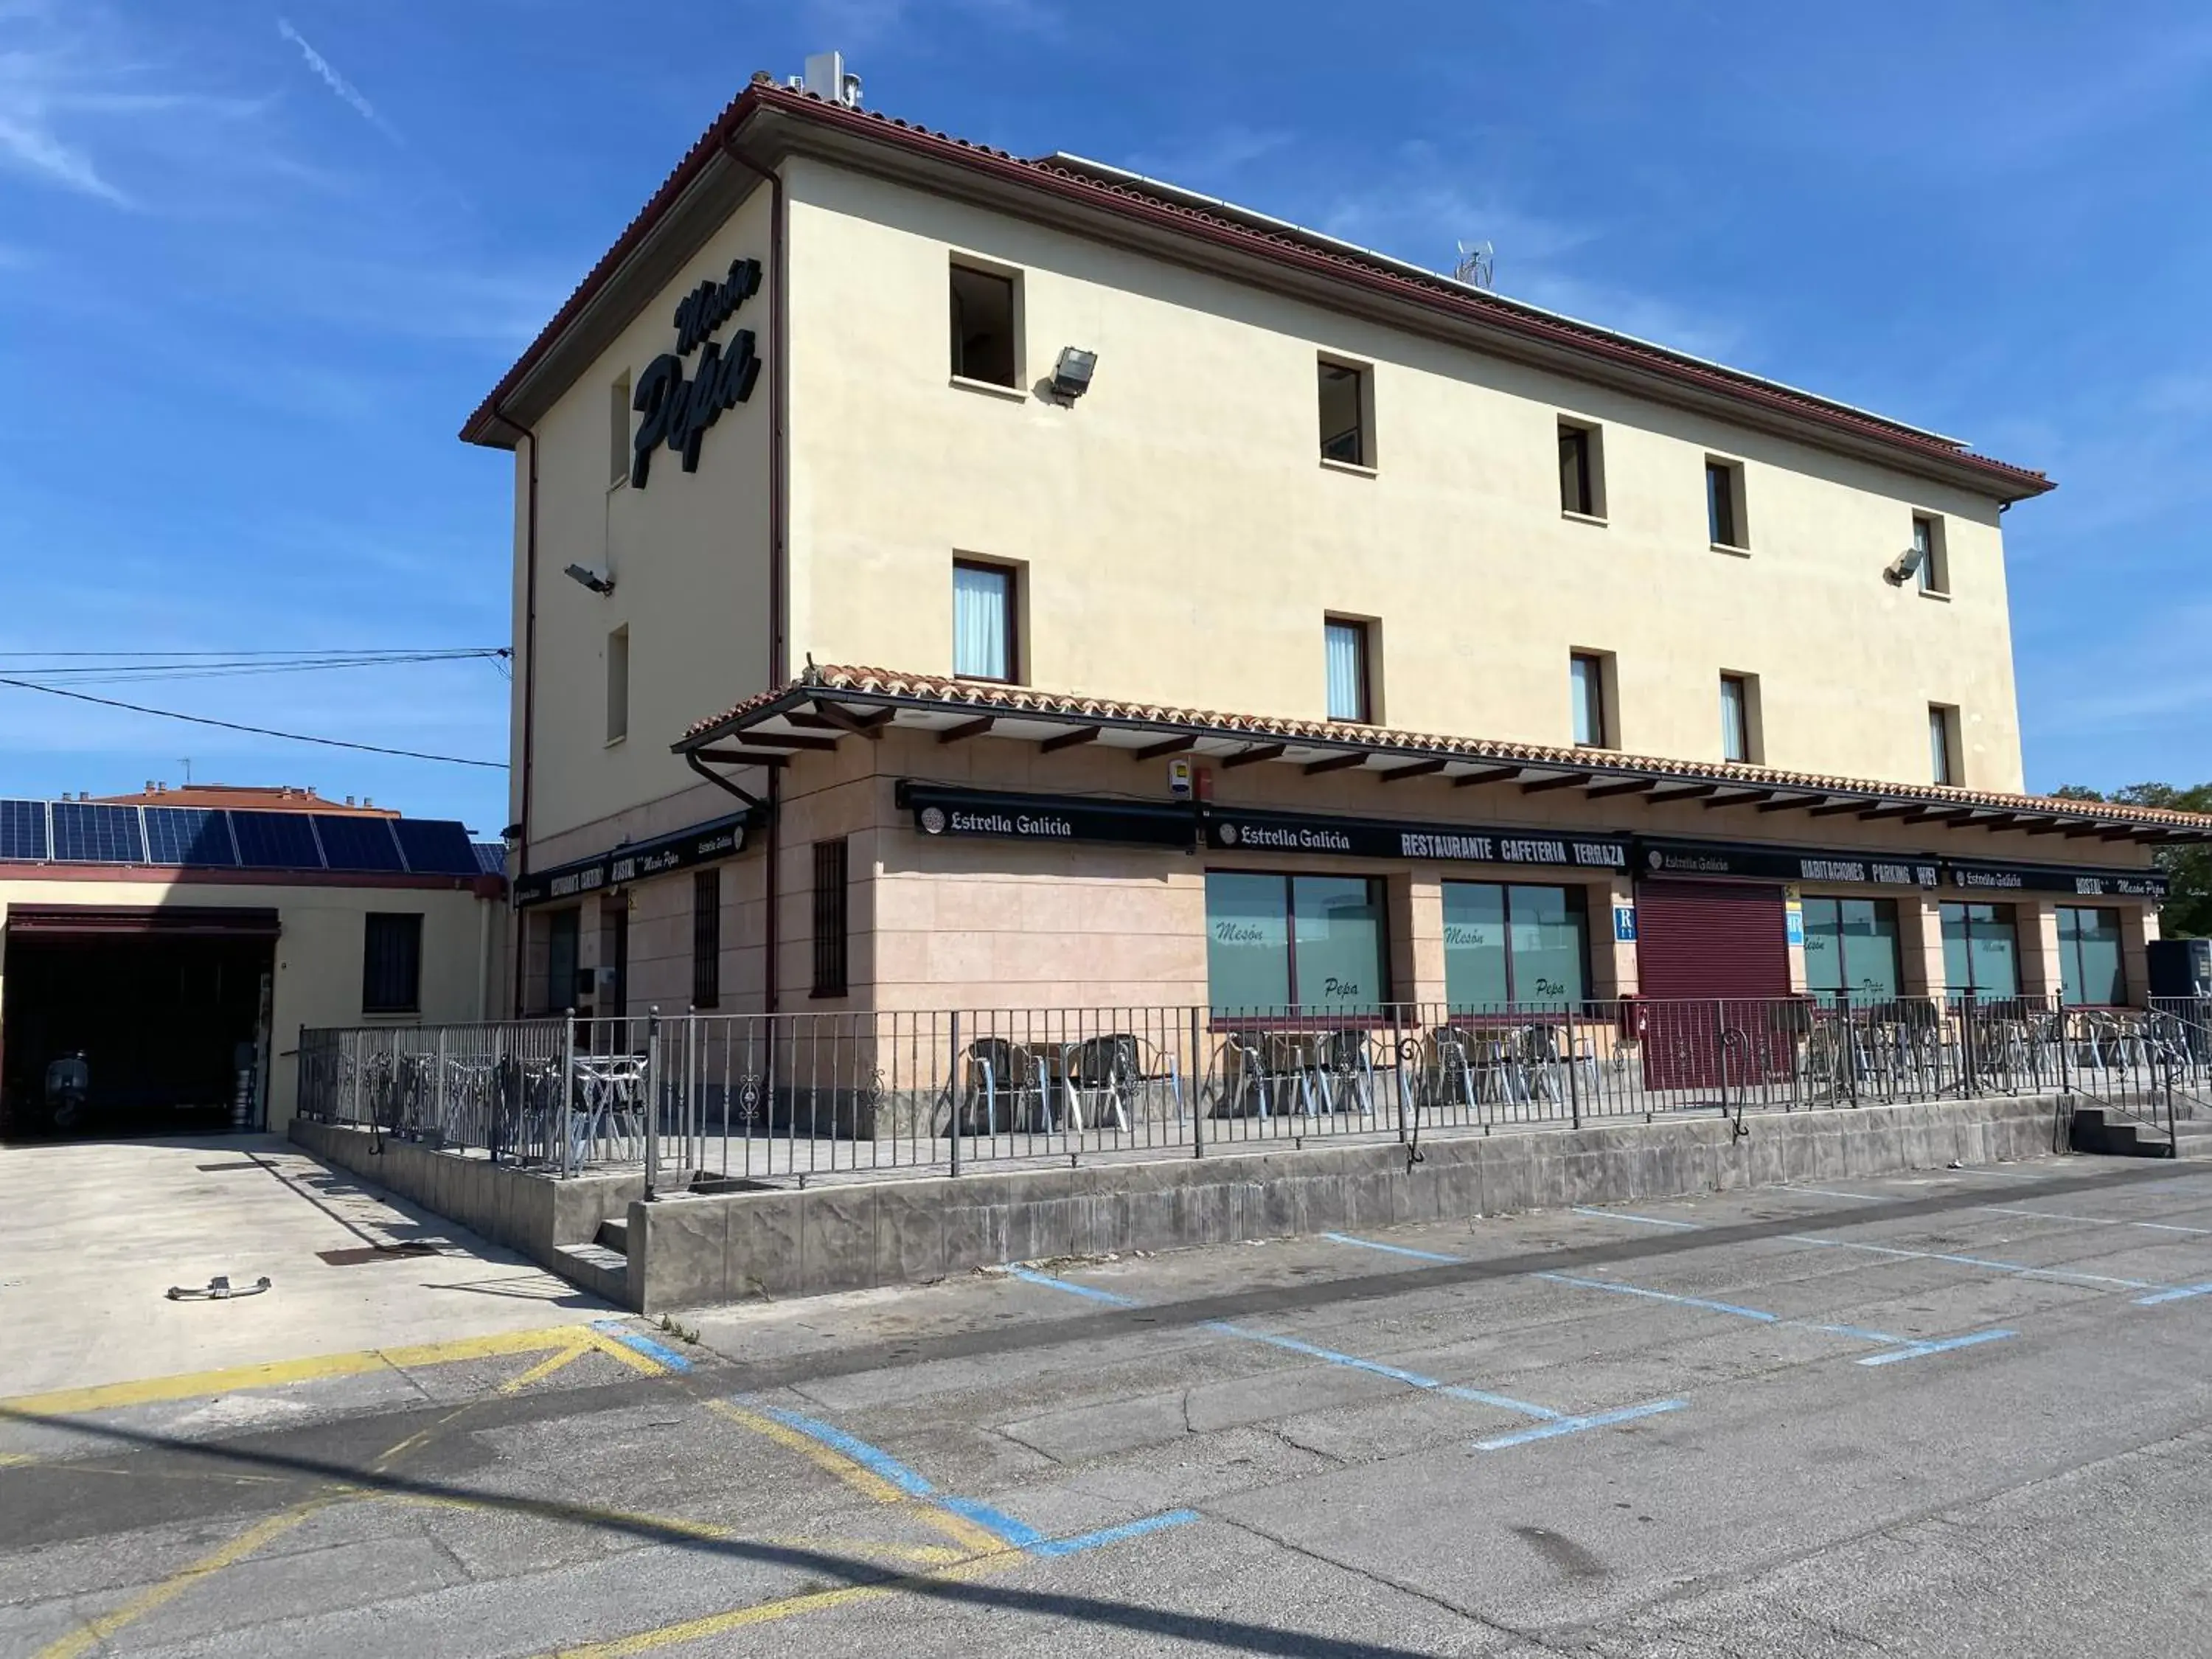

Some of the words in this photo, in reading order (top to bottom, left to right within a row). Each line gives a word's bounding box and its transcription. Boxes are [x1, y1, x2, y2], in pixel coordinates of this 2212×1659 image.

[632, 329, 762, 490] Pepa
[950, 811, 1012, 833] Estrella
[1016, 814, 1072, 836] Galicia
[1240, 825, 1298, 847] Estrella
[1300, 828, 1350, 850] Galicia
[1401, 833, 1493, 859] RESTAURANTE
[1501, 841, 1567, 862] CAFETERIA
[1572, 843, 1626, 866] TERRAZA
[1801, 859, 1865, 882] HABITACIONES
[1873, 863, 1911, 884] PARKING
[1621, 909, 1633, 928] R
[1217, 922, 1263, 942] Mesón
[1444, 926, 1484, 945] Mesón
[1325, 977, 1359, 1000] Pepa
[1536, 978, 1565, 998] Pepa
